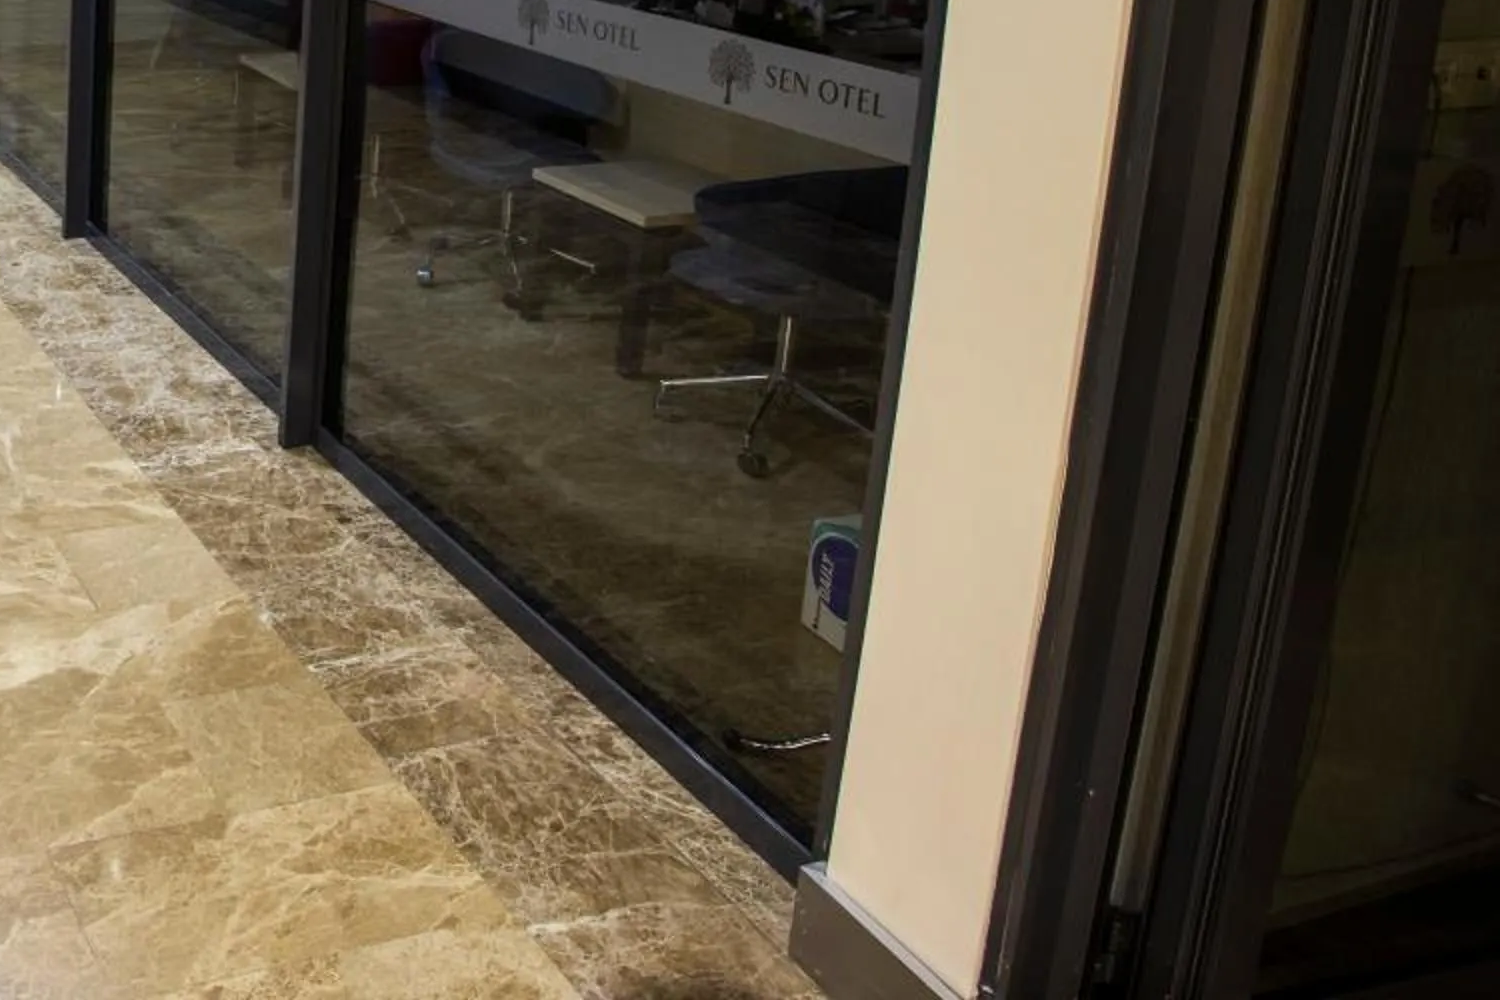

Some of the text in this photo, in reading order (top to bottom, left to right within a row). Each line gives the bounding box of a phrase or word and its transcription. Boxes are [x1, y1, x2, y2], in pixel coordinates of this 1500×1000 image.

[555, 10, 640, 51] SEN OTEL
[764, 64, 887, 119] SEN OTEL
